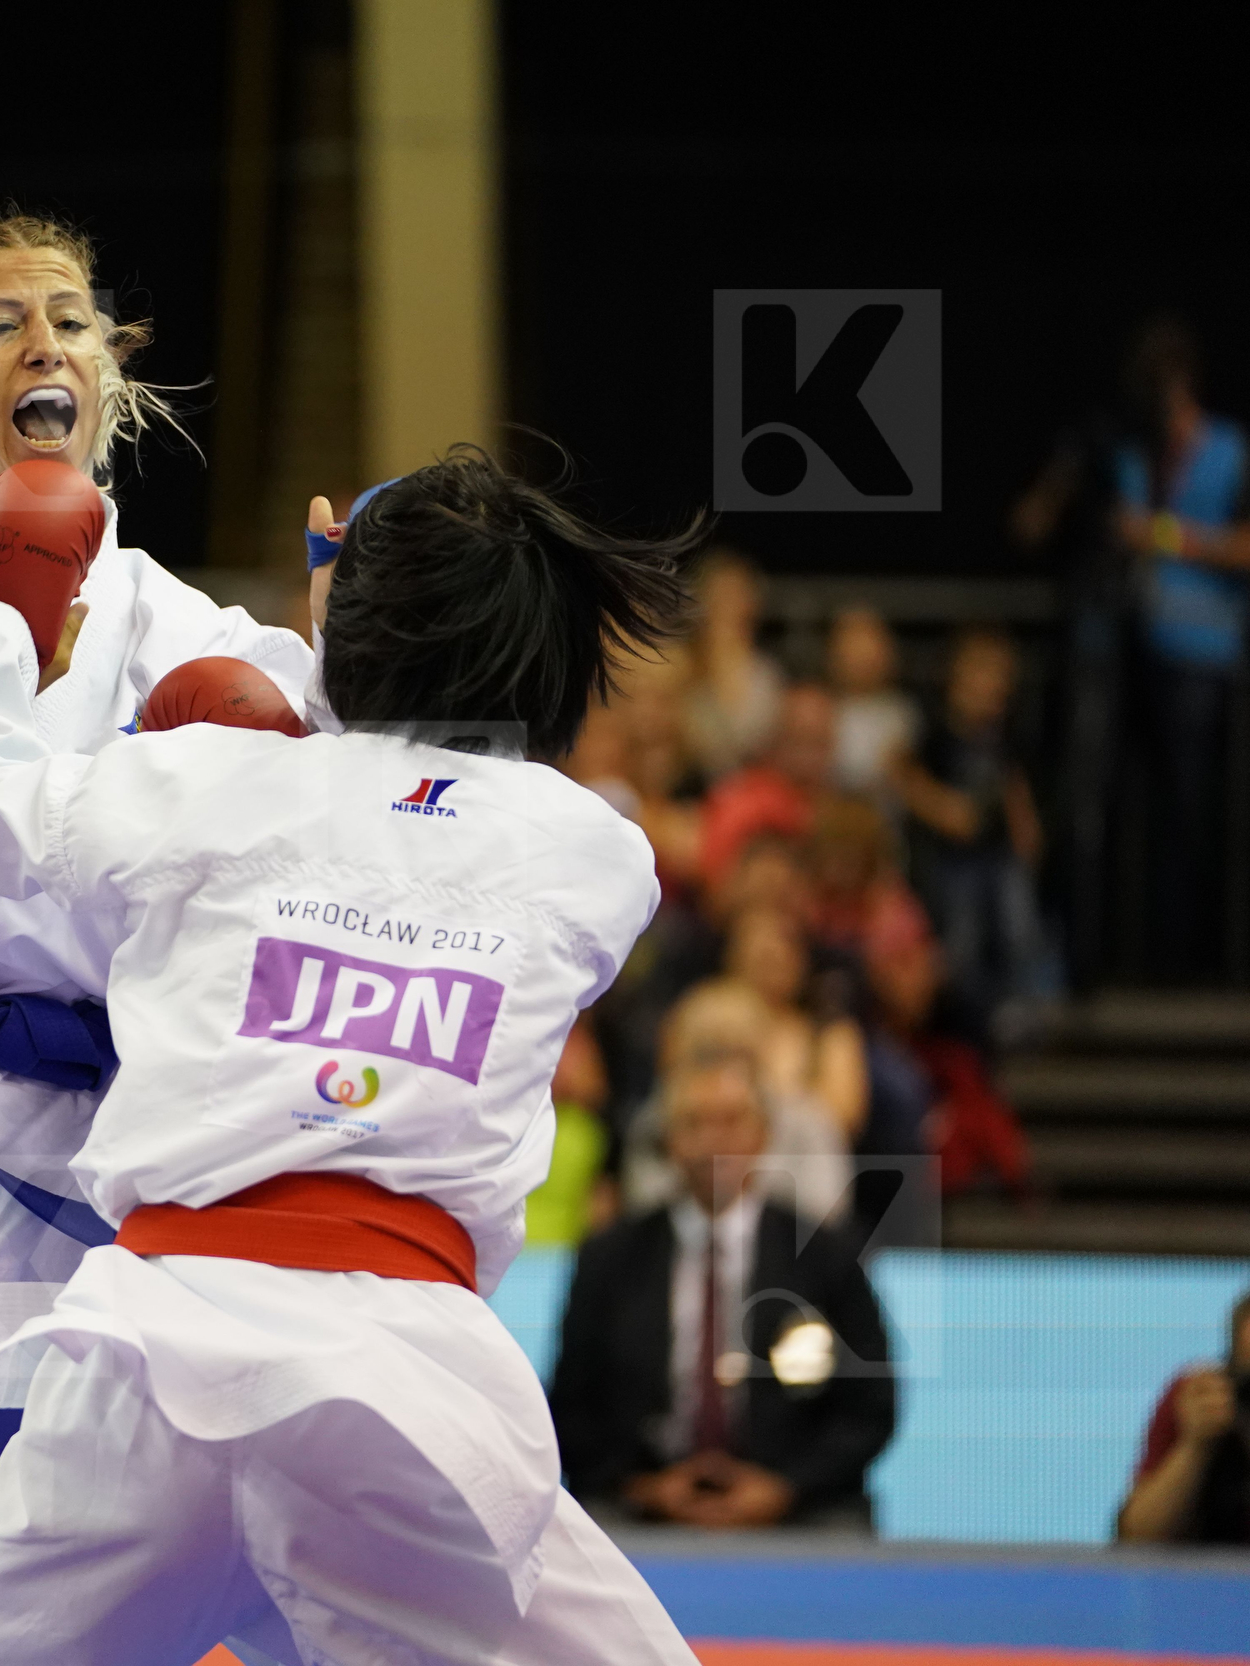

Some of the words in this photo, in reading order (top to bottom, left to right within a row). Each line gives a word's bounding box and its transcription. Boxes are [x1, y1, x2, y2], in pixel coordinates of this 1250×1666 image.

[24, 544, 72, 567] APPROVED
[391, 801, 457, 818] HIROTA
[277, 898, 420, 945] WROCŁAW
[432, 929, 505, 955] 2017
[269, 956, 472, 1063] JPN
[291, 1110, 309, 1120] THE
